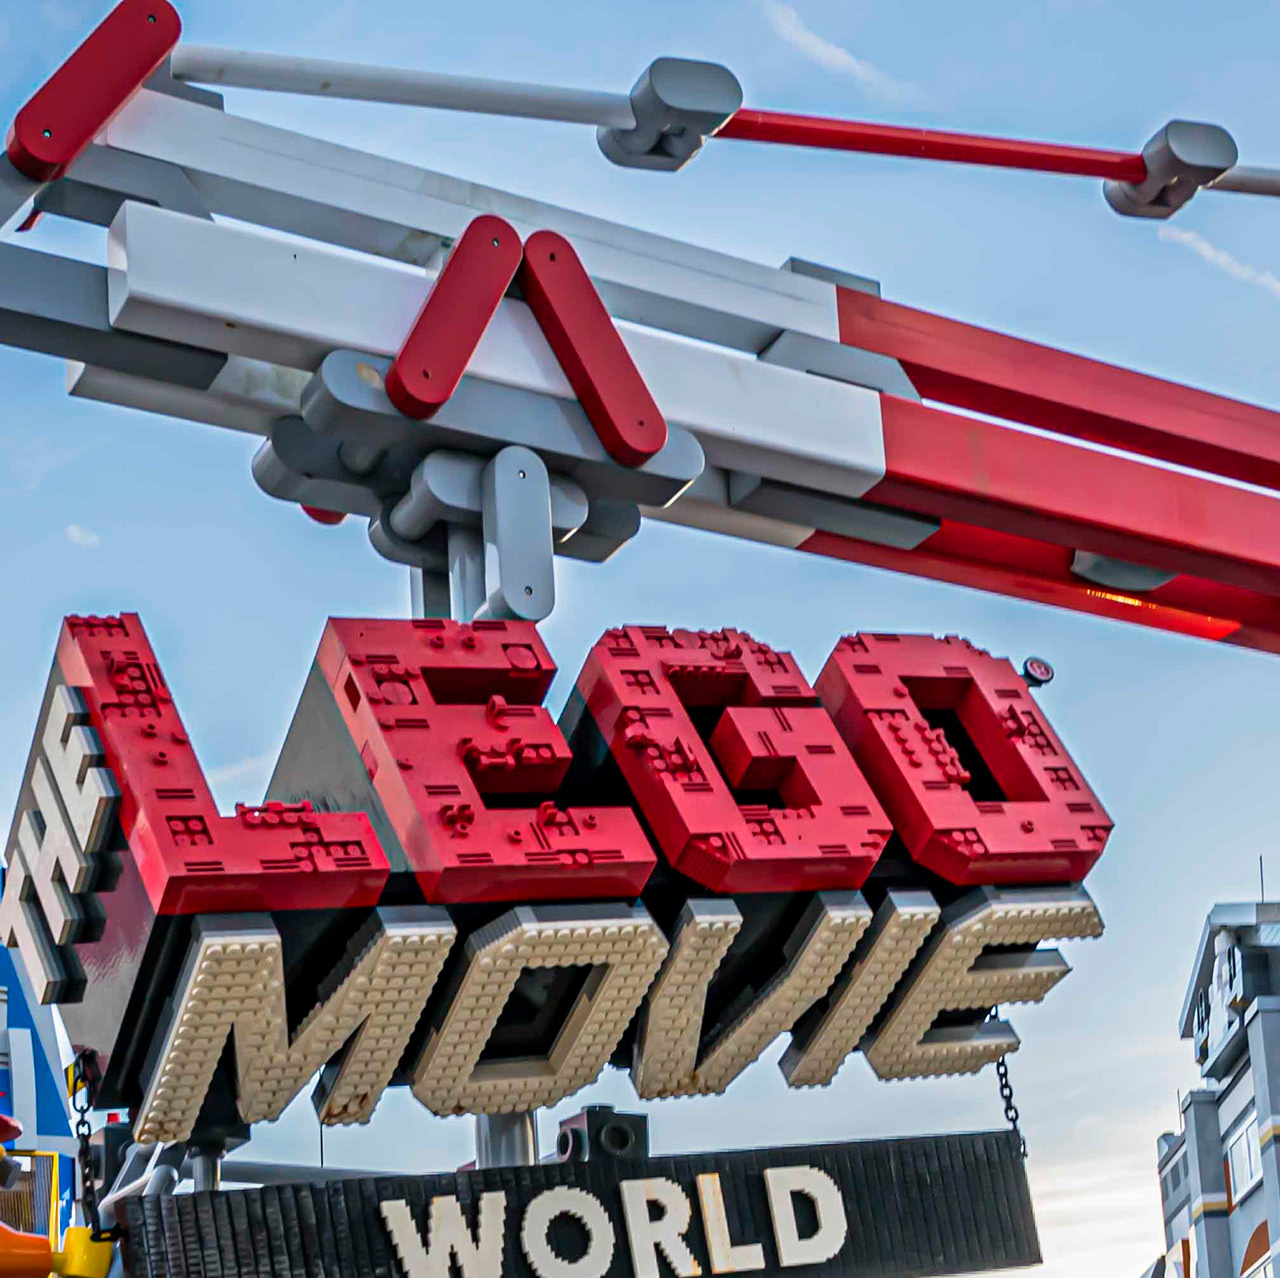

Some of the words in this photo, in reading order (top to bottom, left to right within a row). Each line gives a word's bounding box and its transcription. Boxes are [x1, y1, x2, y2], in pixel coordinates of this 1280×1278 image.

[0, 684, 119, 1005] THE
[59, 612, 1114, 916] LEGO
[132, 882, 1106, 1145] MOVIE
